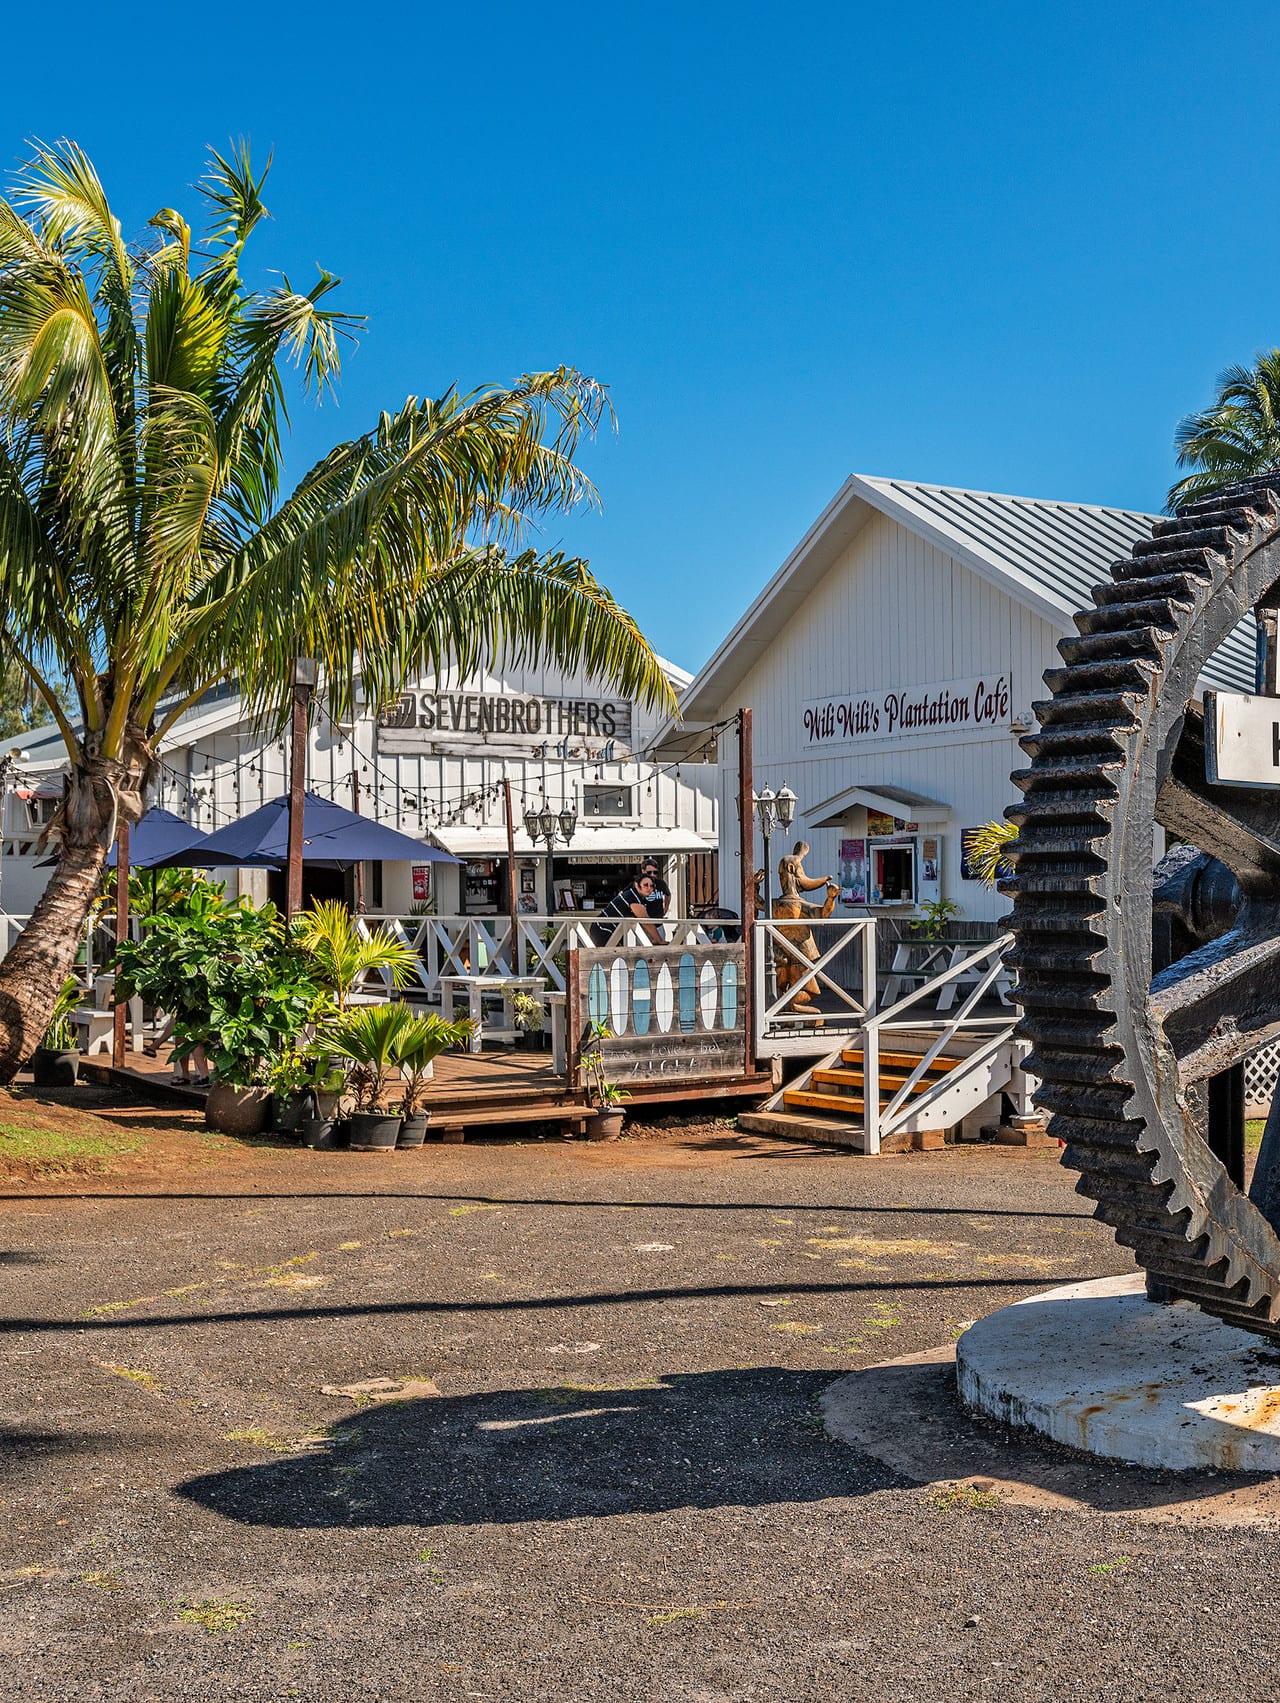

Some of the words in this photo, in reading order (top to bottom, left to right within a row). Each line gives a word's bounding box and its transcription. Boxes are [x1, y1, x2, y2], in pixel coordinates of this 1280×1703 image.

[420, 693, 616, 737] SEVENBROTHERS
[803, 703, 835, 742] Wili
[836, 700, 879, 738] Wili's
[884, 690, 970, 733] Plantation
[974, 676, 1009, 724] Café
[556, 735, 580, 759] the
